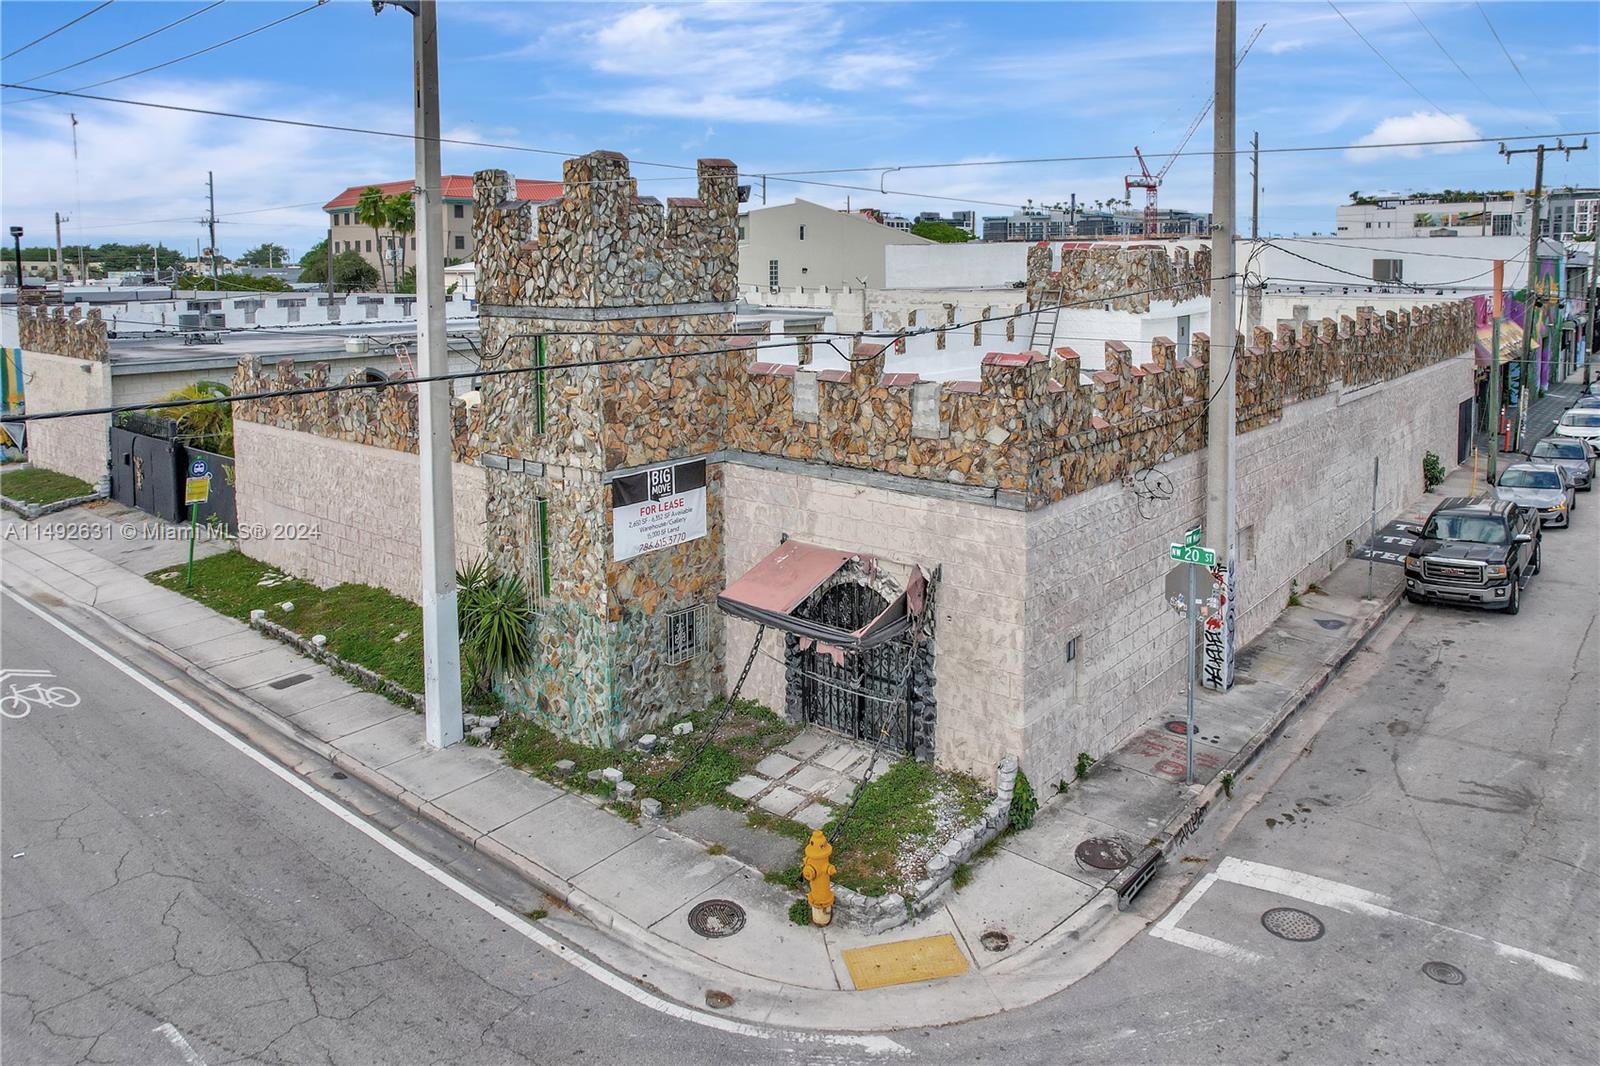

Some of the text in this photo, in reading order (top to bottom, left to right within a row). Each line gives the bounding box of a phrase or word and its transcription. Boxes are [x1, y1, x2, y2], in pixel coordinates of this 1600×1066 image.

[651, 468, 671, 486] BIG
[651, 482, 671, 495] MOVE
[640, 497, 685, 517] FOR LEASE
[671, 507, 693, 517] Available
[640, 516, 688, 533] Warehouse/Gallery
[667, 526, 680, 534] Land
[1172, 548, 1181, 557] NW
[1184, 548, 1200, 562] 20
